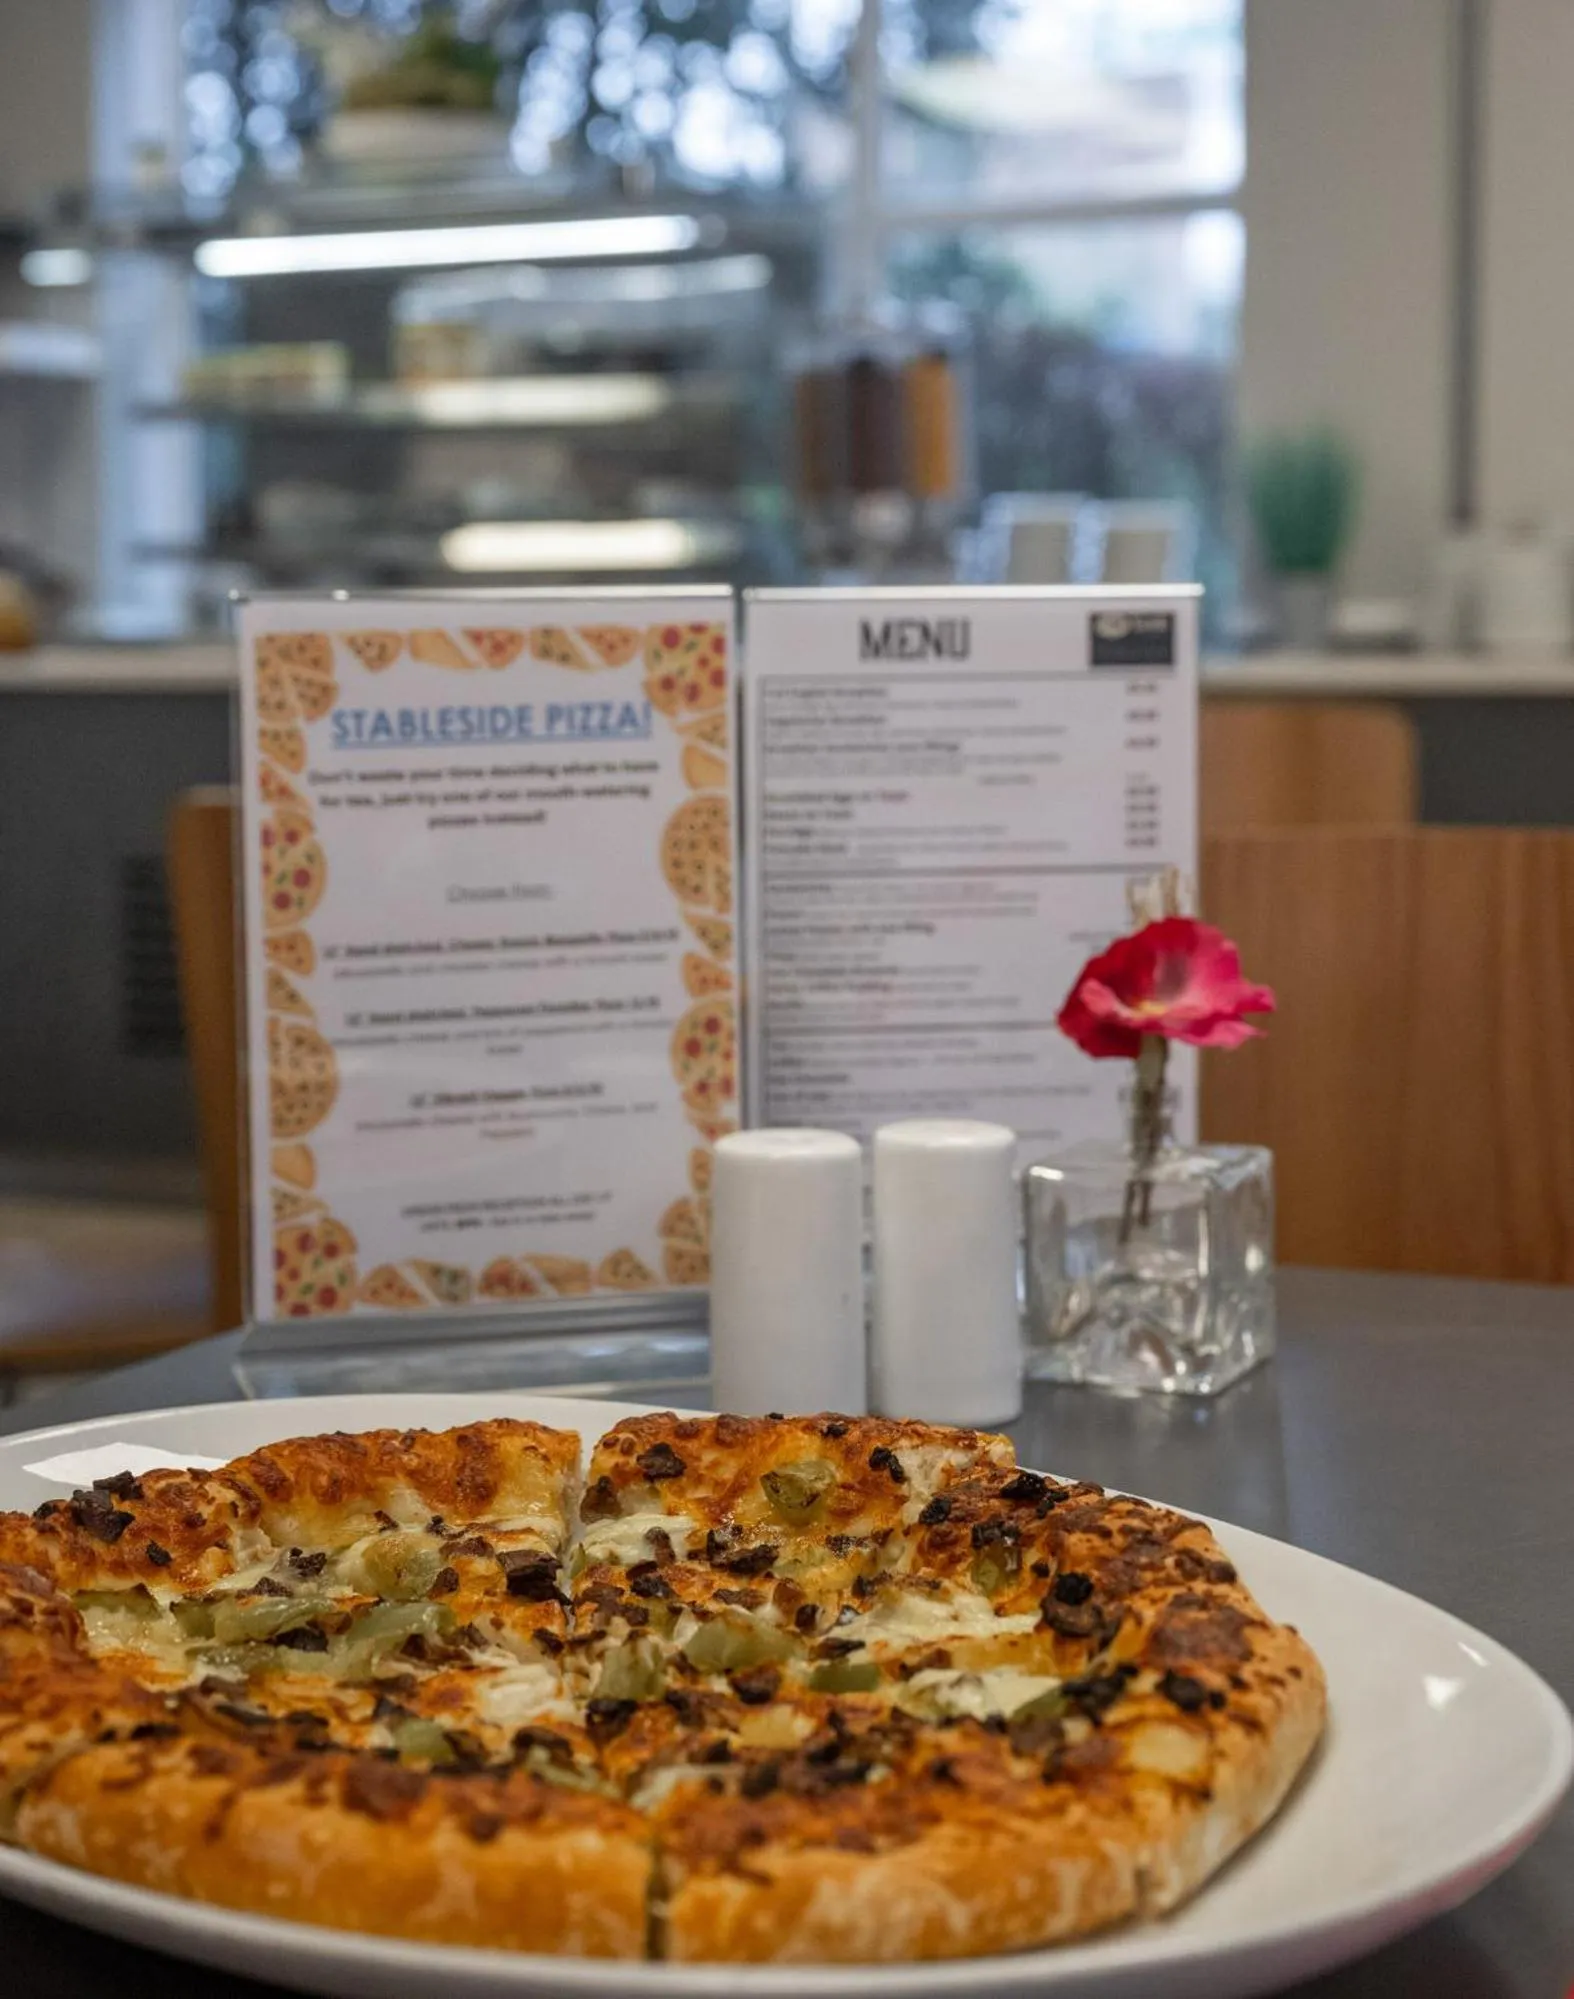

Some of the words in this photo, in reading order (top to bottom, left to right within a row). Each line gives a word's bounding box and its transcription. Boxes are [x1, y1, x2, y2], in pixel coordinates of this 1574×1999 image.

[859, 619, 970, 662] MENU
[332, 704, 533, 741] STABLESIDE
[547, 700, 652, 734] PIZZA!
